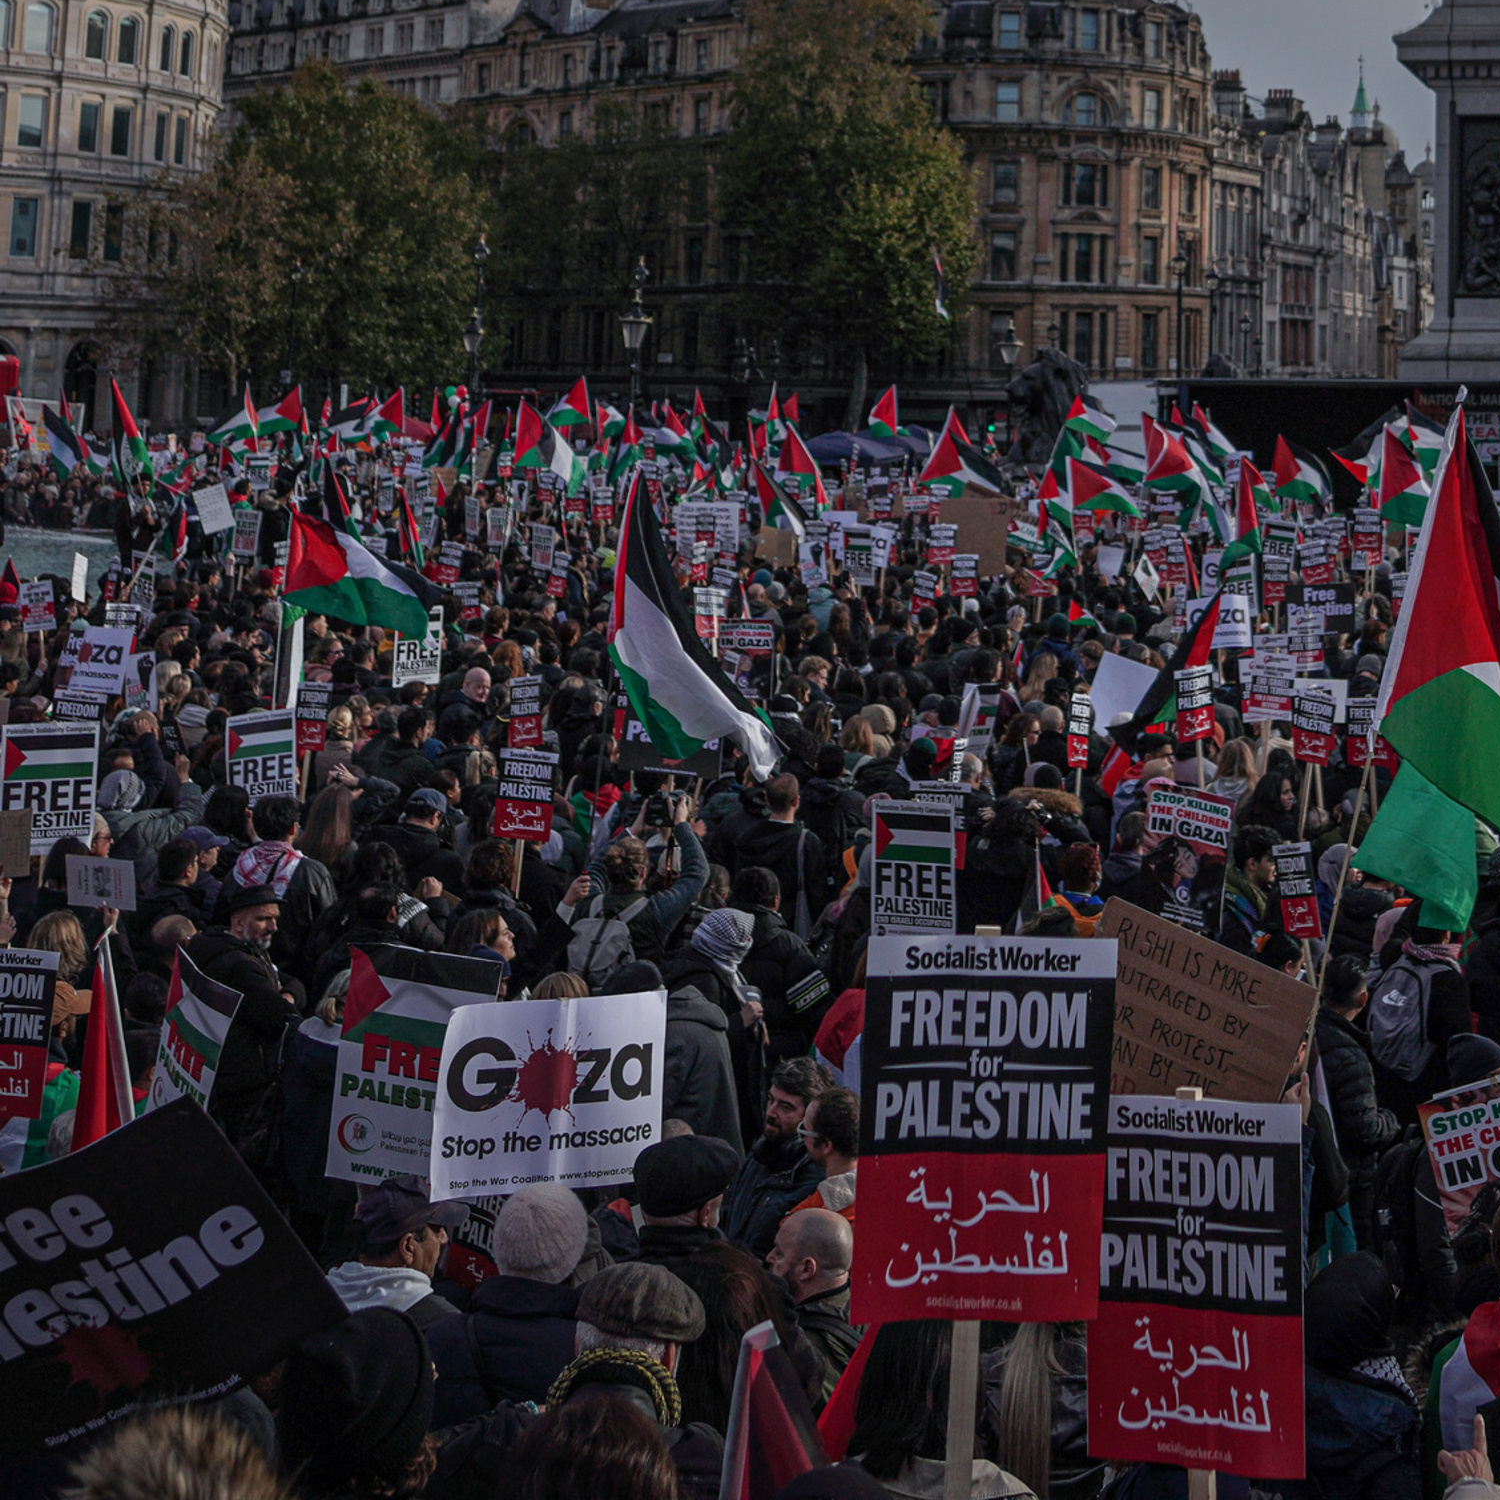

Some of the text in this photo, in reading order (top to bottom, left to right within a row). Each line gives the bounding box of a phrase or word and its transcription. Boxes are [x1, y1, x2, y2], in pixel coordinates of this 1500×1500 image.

[1303, 587, 1336, 602] Free
[55, 701, 100, 719] FREEDOM
[228, 753, 292, 786] FREE
[504, 760, 552, 780] FREEDOM
[2, 779, 92, 812] FREE
[499, 782, 552, 802] PALESTINE
[1152, 791, 1229, 818] STOP KILLING
[1151, 804, 1229, 829] THE CHILDREN
[1151, 816, 1226, 846] IN GAZA
[876, 861, 952, 900] FREE
[875, 896, 952, 917] PALESTINE
[4, 953, 43, 967] Worker
[1116, 917, 1263, 1006] RISHI IS MORE
[889, 989, 1088, 1049] FREEDOM
[1223, 1013, 1250, 1039] BY
[446, 1036, 653, 1113] Gza
[969, 1048, 1003, 1078] for
[1148, 1052, 1173, 1085] BY
[873, 1080, 1095, 1141] PALESTINE
[1432, 1108, 1487, 1135] STOP
[441, 1134, 496, 1160] Stop
[503, 1131, 542, 1153] the
[549, 1122, 652, 1151] massacre
[1433, 1133, 1475, 1157] THE
[449, 1181, 469, 1191] Stop
[472, 1178, 487, 1188] the
[490, 1176, 509, 1186] War
[511, 1174, 555, 1186] Coalition
[1107, 1146, 1275, 1213] FREEDOM
[1444, 1155, 1484, 1187] IN
[905, 1165, 1050, 1228] الحرية
[1176, 1207, 1205, 1236] for
[885, 1226, 1069, 1287] لفلسطين
[1100, 1233, 1288, 1302] PALESTINE
[925, 1294, 1023, 1311] socialistworker.co.uk
[1132, 1315, 1251, 1378] الحرية
[1117, 1376, 1272, 1434] لفلسطين
